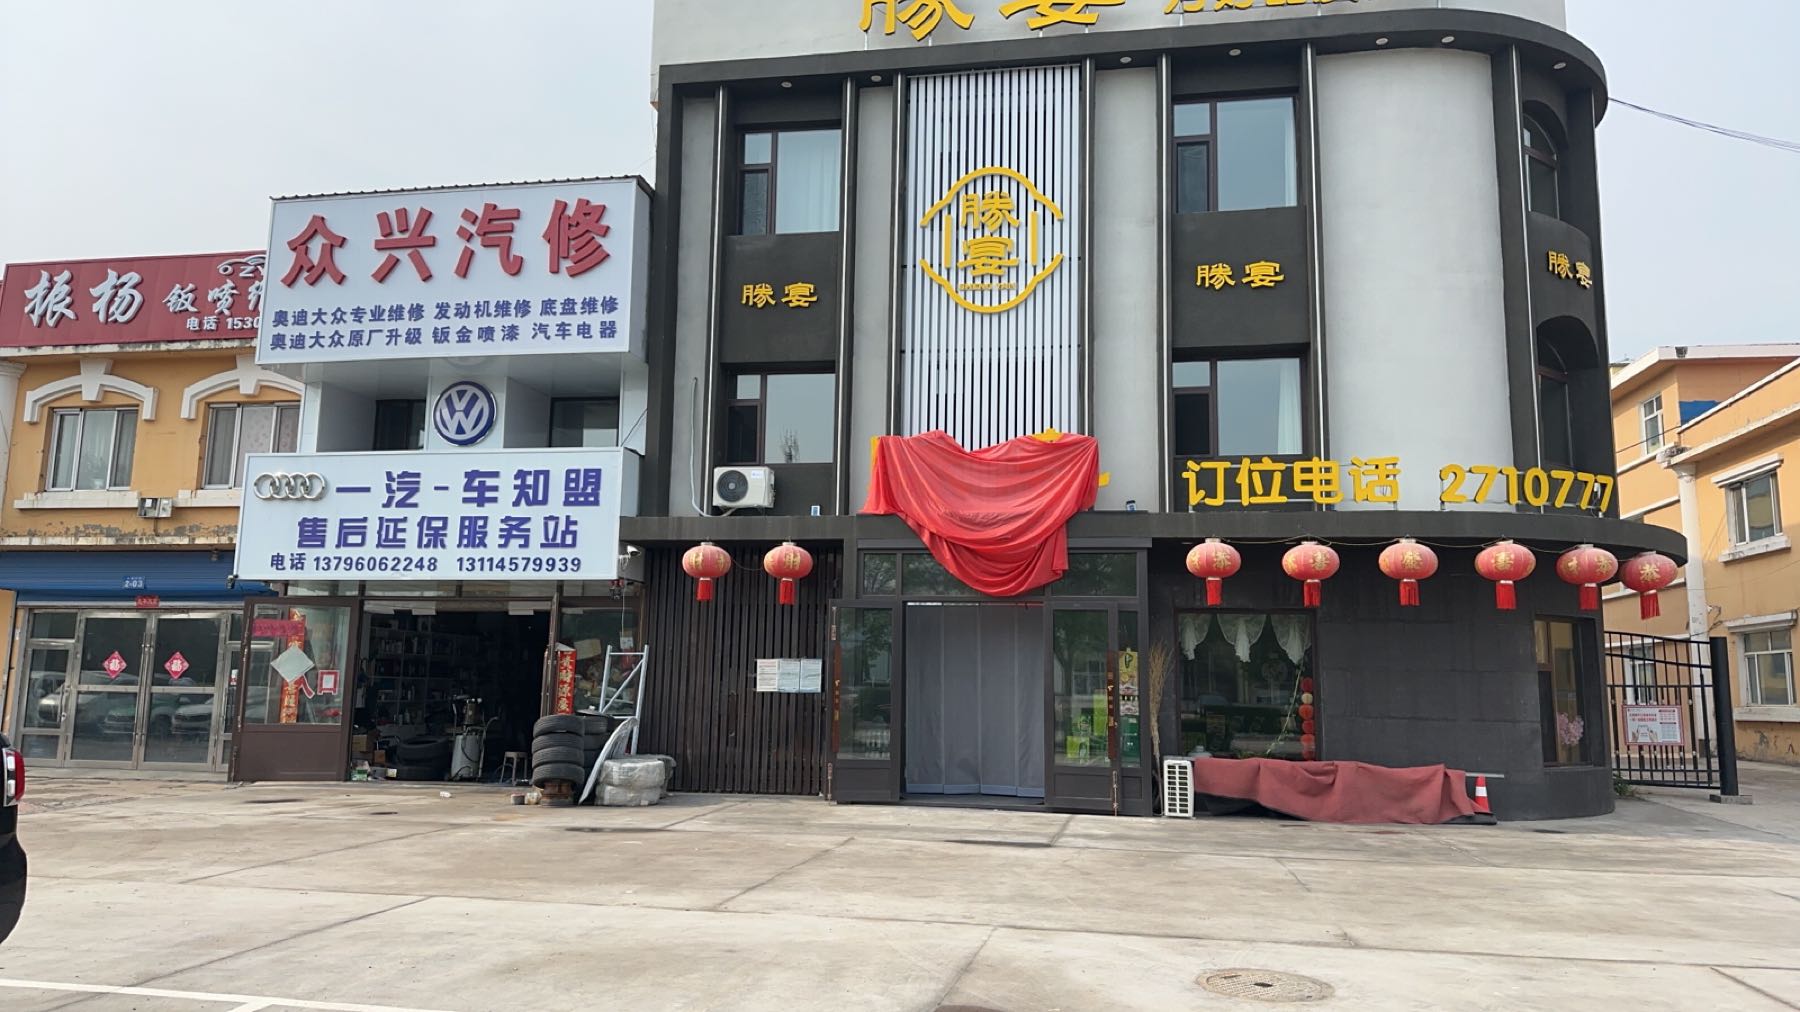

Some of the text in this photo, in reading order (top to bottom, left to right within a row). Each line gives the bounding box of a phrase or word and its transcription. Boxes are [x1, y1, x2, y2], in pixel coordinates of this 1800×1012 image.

[281, 198, 611, 288] 众兴汽修
[24, 268, 144, 328] 振杨
[272, 296, 619, 327] 奥迪大众专业维修 发动机维修 底盘维修
[186, 316, 218, 331] 电话
[270, 320, 618, 350] 奥迪大众原厂升级 钣金喷漆 汽车电器
[1181, 456, 1614, 512] 订位电话 2710777
[296, 515, 579, 550] 售后延保服务站
[270, 552, 582, 573] 电话 13796062248 13114579939
